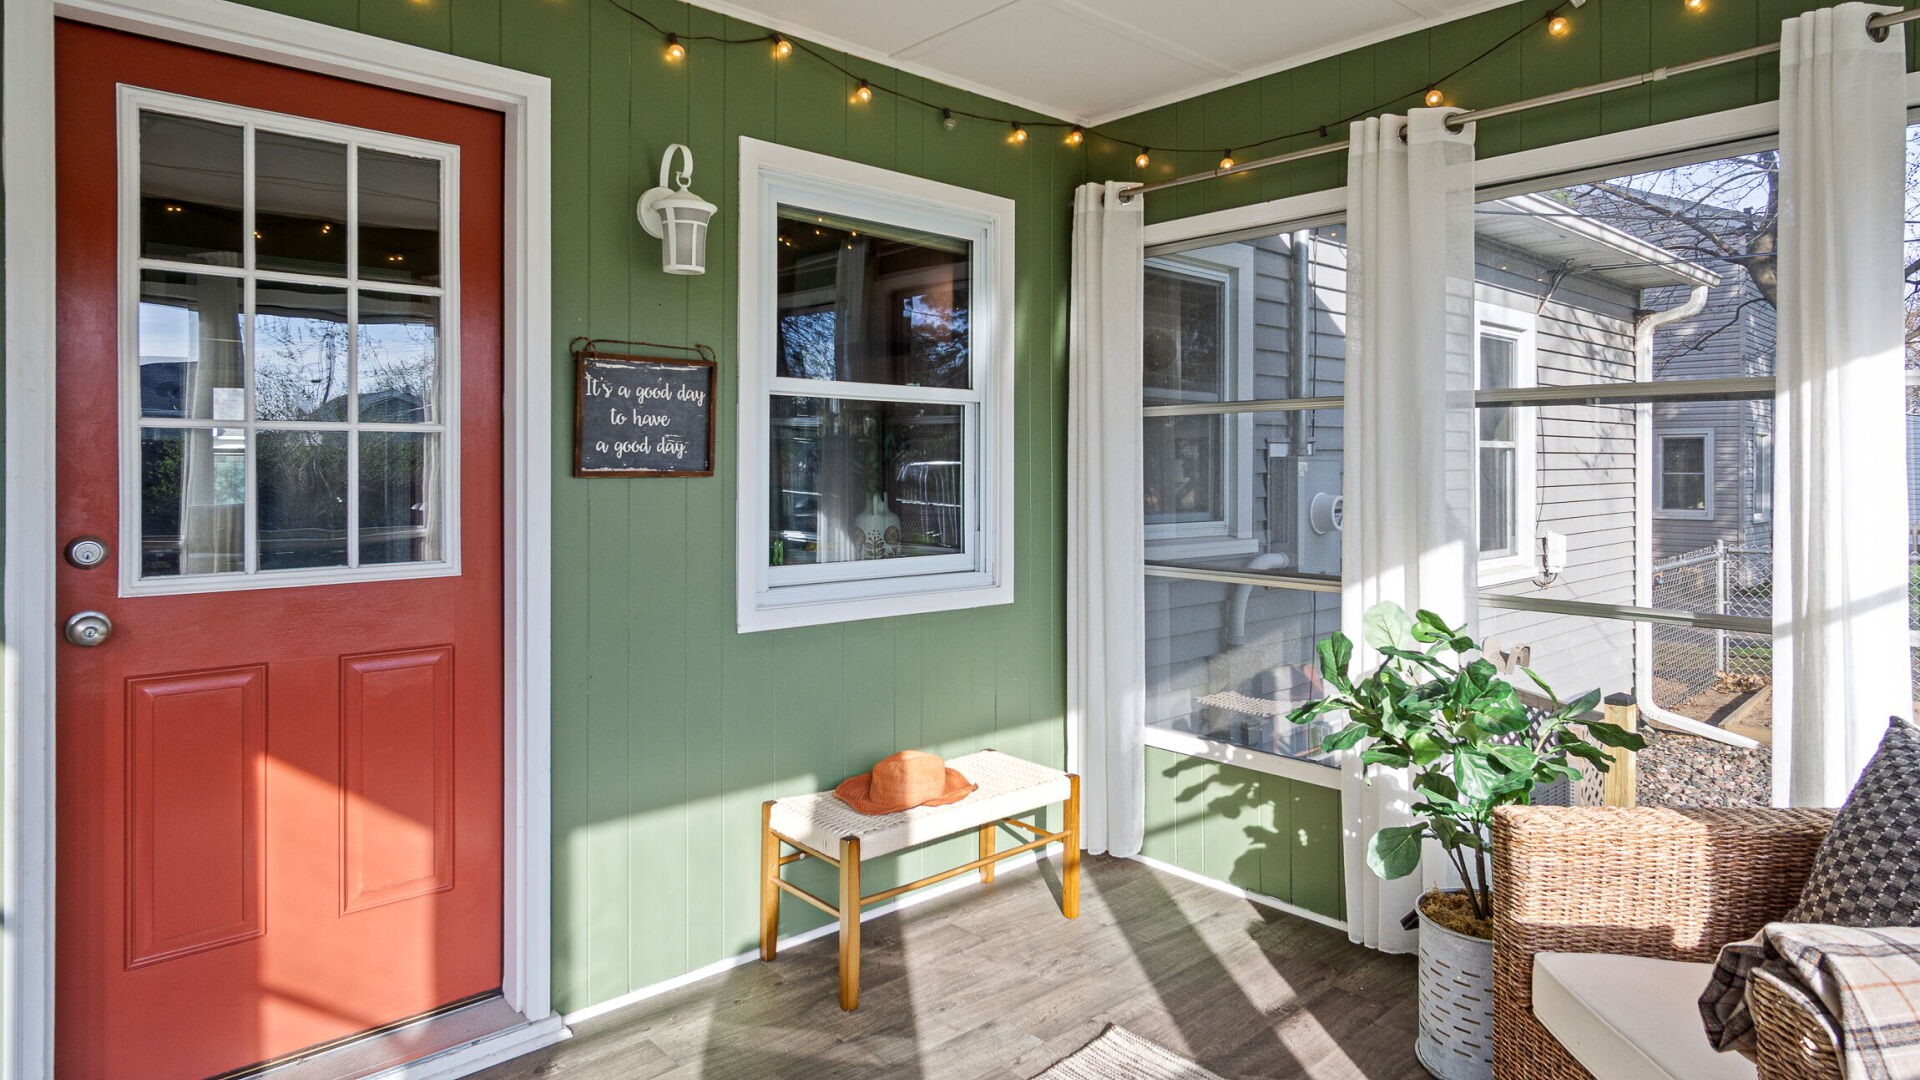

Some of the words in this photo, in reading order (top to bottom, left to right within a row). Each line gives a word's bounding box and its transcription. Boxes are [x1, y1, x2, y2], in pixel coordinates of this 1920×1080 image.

[585, 376, 613, 398] It's
[618, 385, 630, 398] a
[636, 382, 672, 404] good
[677, 384, 706, 406] day
[610, 408, 627, 425] to
[633, 408, 670, 426] have
[596, 440, 608, 453] a
[614, 436, 651, 458] good
[657, 436, 688, 459] day.
